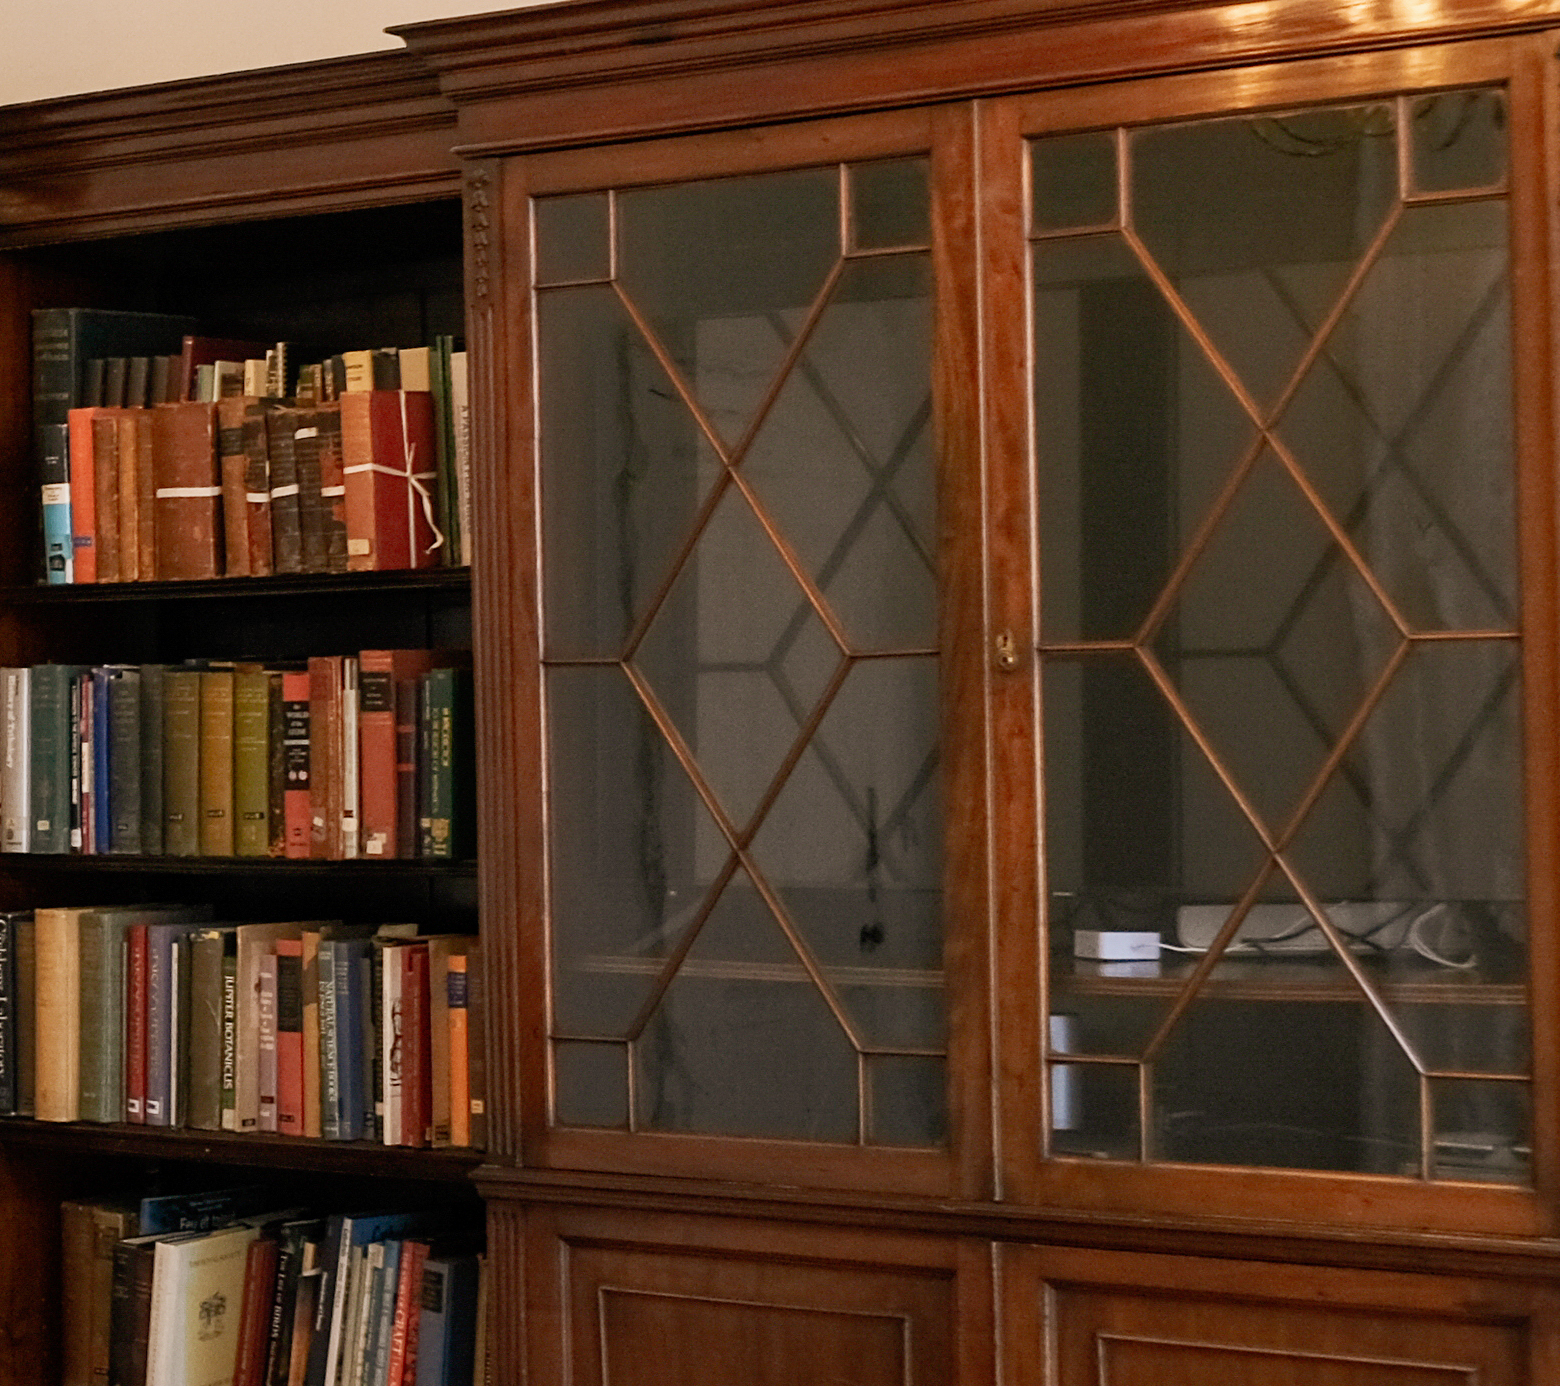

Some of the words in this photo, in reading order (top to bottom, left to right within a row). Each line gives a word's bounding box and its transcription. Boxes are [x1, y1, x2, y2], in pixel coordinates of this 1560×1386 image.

[223, 975, 235, 1018] JUPITER
[223, 1022, 235, 1090] BOTANICUS
[271, 1305, 282, 1338] BIRDS
[391, 1309, 405, 1356] CRAFT
